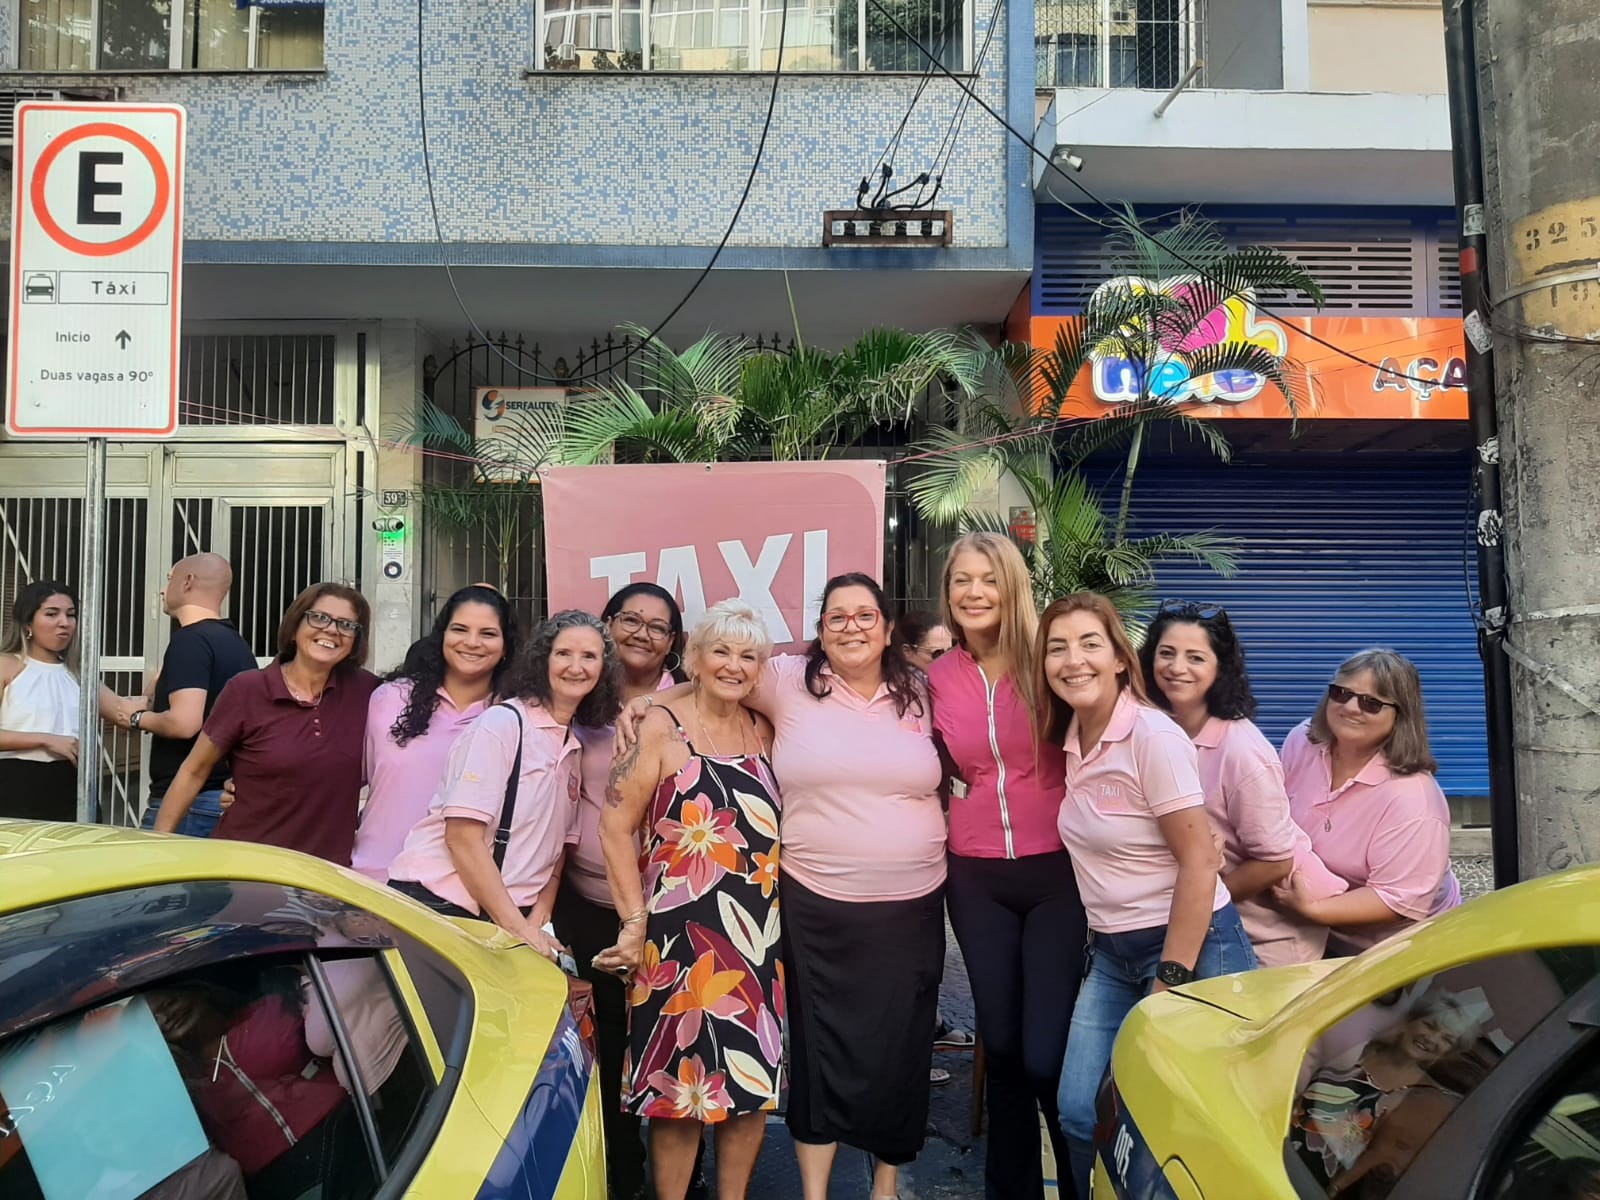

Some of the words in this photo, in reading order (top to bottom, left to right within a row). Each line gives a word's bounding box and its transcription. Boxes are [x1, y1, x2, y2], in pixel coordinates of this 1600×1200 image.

[77, 151, 124, 225] E
[91, 280, 137, 296] Táxi
[40, 369, 73, 380] Duas
[77, 372, 114, 384] vagas
[116, 373, 124, 381] a
[590, 529, 828, 644] TAXI
[1100, 784, 1120, 797] TAXI
